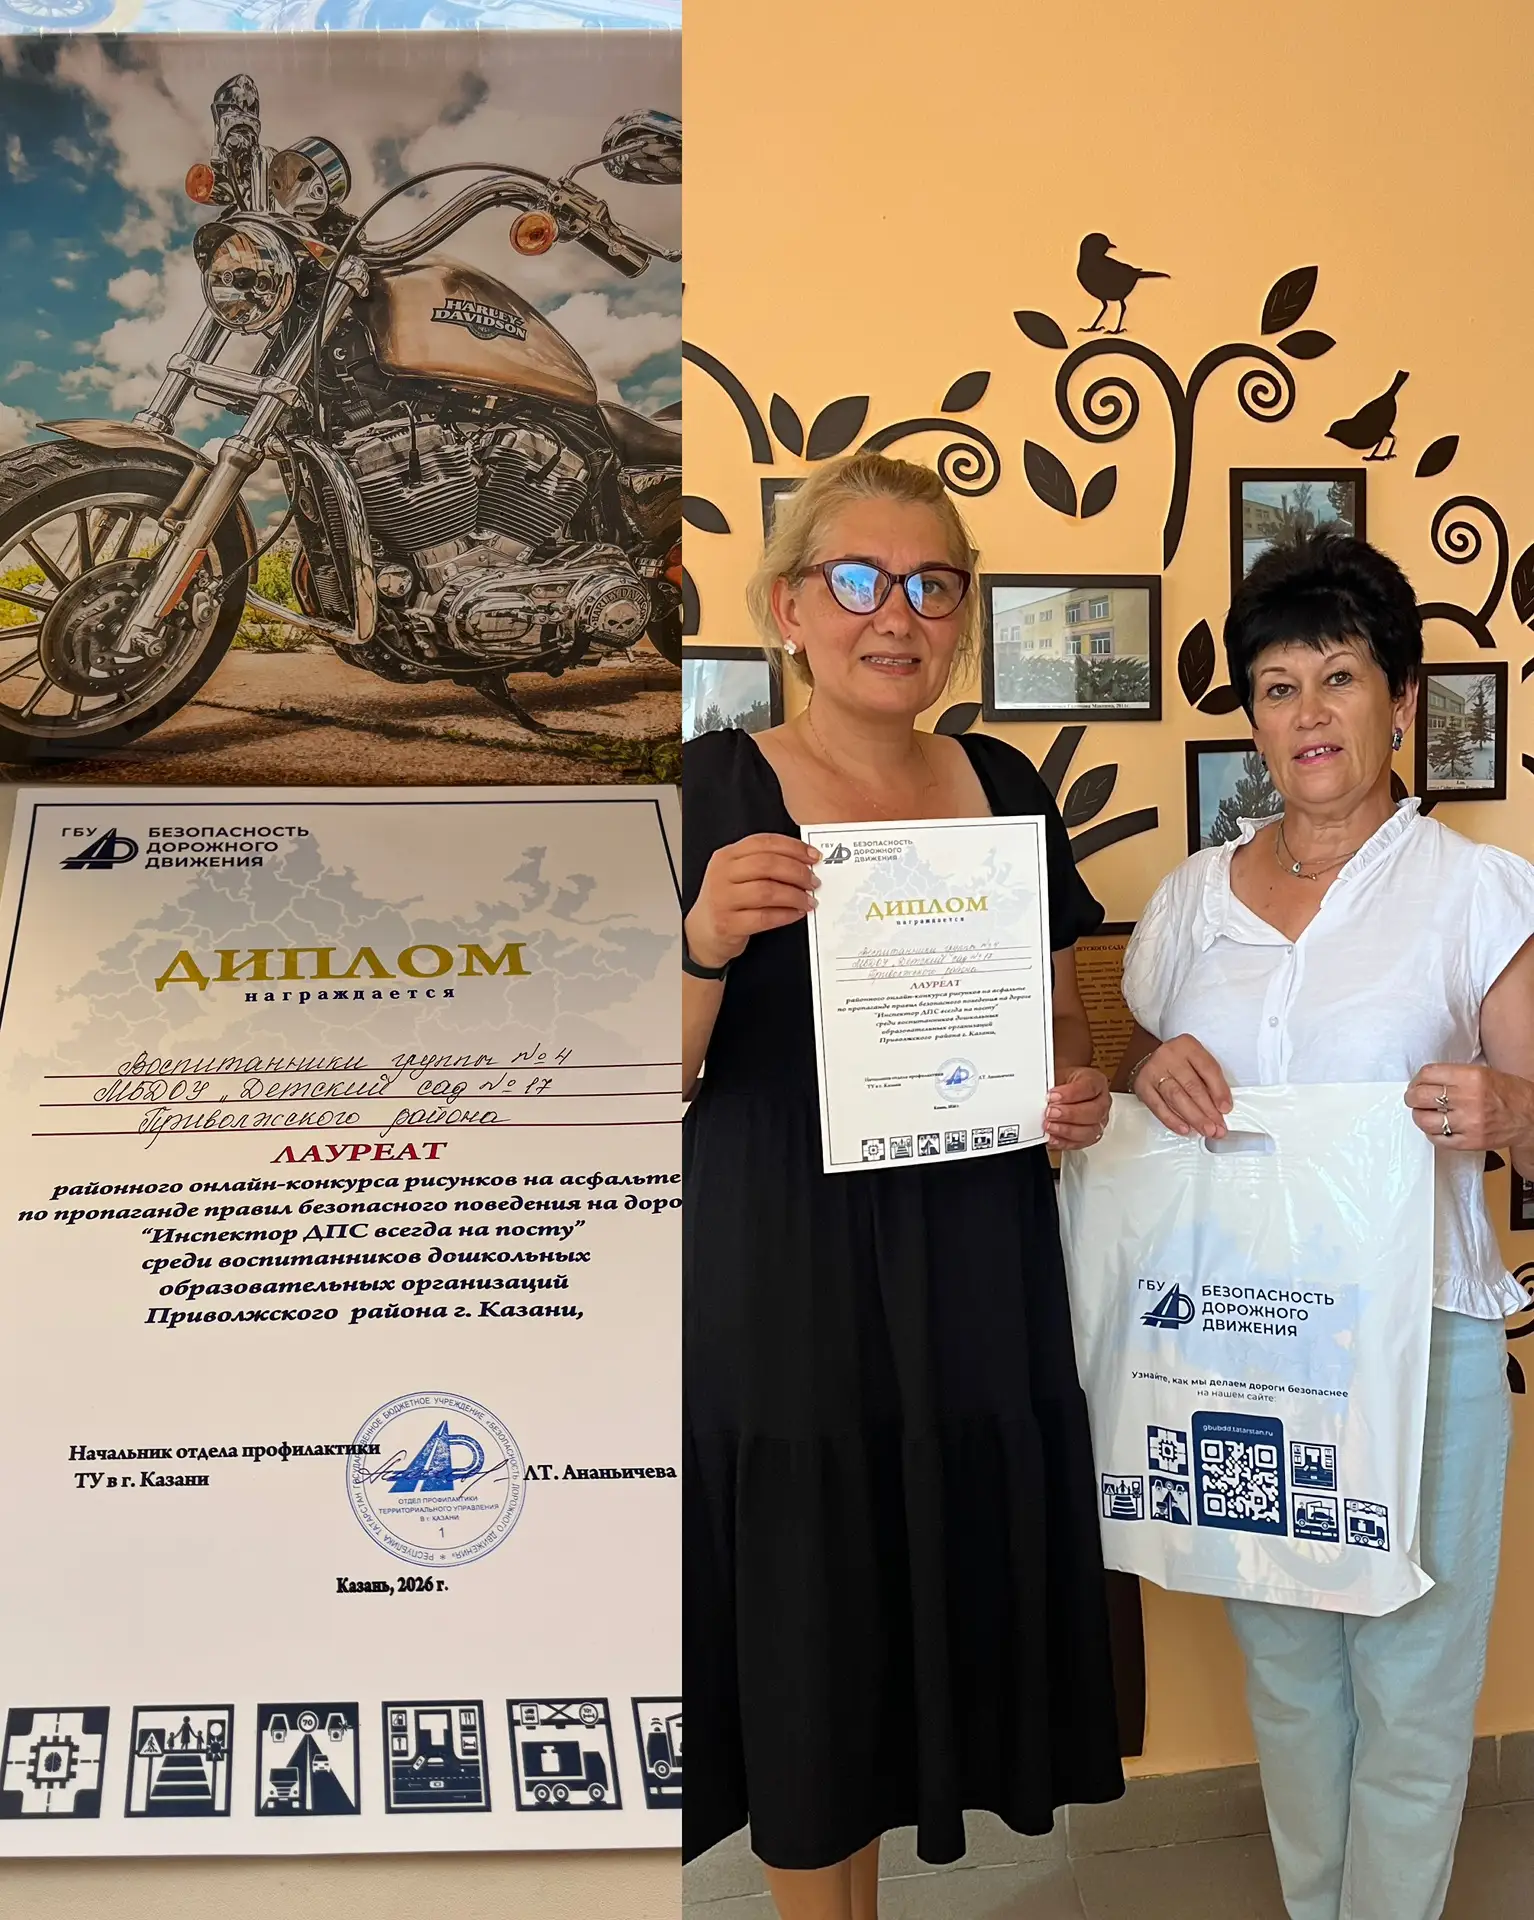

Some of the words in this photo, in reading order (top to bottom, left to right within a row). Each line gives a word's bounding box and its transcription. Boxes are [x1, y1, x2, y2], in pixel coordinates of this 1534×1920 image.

[434, 309, 526, 338] DAVIDSON
[446, 299, 525, 327] HARLEY-
[62, 827, 98, 838] ГБУ
[147, 825, 309, 838] БЕЗОПАСНОСТЬ
[146, 840, 279, 854] ДОРОЖНОГО
[853, 839, 913, 847] БЕЗОПАСНОСТЬ
[853, 847, 902, 855] ДОРОЖНОГО
[144, 855, 264, 869] ДВИЖЕНИЯ
[854, 855, 898, 863] ДВИЖЕНИЯ
[865, 895, 989, 921] ДИПЛОМ
[154, 942, 532, 991] ДИПЛОМ
[244, 985, 457, 1005] награждается
[910, 979, 961, 990] ЛАУРЕАТ
[117, 1050, 368, 1076] Воспитанники
[93, 1078, 210, 1102] МБДОУ
[416, 1078, 468, 1104] сад
[138, 1105, 361, 1150] Приволжского
[379, 1105, 512, 1139] района
[270, 1141, 448, 1164] ЛАУРЕАТ
[49, 1179, 184, 1202] районного
[188, 1176, 400, 1194] онлайн-конкурса
[403, 1174, 518, 1193] рисунков
[523, 1175, 554, 1186] на
[558, 1170, 682, 1191] асфальте
[18, 1210, 49, 1222] по
[53, 1203, 199, 1225] пропаганде
[204, 1204, 293, 1222] правил
[298, 1198, 448, 1215] безопасного
[453, 1196, 582, 1212] поведения
[587, 1199, 619, 1211] на
[302, 1223, 369, 1243] ДПС
[374, 1222, 453, 1238] всегда
[458, 1225, 490, 1237] на
[141, 1252, 213, 1274] среди
[218, 1252, 422, 1268] воспитанников
[427, 1246, 591, 1264] дошкольных
[158, 1278, 396, 1300] образовательных
[401, 1274, 569, 1296] организаций
[1138, 1279, 1165, 1291] ГБУ
[1202, 1285, 1335, 1306] БЕЗОПАСНОСТЬ
[143, 1307, 339, 1329] Приволжского
[348, 1303, 448, 1325] района
[453, 1306, 472, 1318] г.
[478, 1301, 584, 1321] Казани,
[1202, 1302, 1308, 1321] ДОРОЖНОГО
[1202, 1318, 1297, 1337] ДВИЖЕНИЯ
[1131, 1371, 1170, 1384] Узнайте,
[1172, 1377, 1189, 1386] как
[1209, 1379, 1247, 1389] делаем
[1249, 1382, 1285, 1392] дороги
[1288, 1384, 1349, 1398] безопаснее
[1197, 1389, 1209, 1397] на
[1211, 1390, 1245, 1399] нашем
[68, 1445, 173, 1461] Начальник
[176, 1446, 239, 1461] отдела
[242, 1441, 381, 1465] профилактики
[382, 1396, 431, 1420] БЮДЖЕТНОЕ
[433, 1396, 485, 1421] УЧРЕЖДЕНИЕ
[496, 1483, 521, 1533] ДОРОЖНОГО
[562, 1464, 678, 1480] Ананьичева
[74, 1472, 106, 1489] ТУ
[106, 1476, 117, 1488] в
[120, 1476, 136, 1488] г.
[139, 1471, 210, 1488] Казани
[378, 1505, 452, 1514] ТЕРРИТОРИАЛЬНОГО
[453, 1503, 500, 1513] УПРАВЛЕНИЯ
[398, 1497, 422, 1505] ОТДЕЛ
[423, 1495, 478, 1504] ПРОФИЛАКТИКИ
[335, 1576, 396, 1597] Казань,
[397, 1575, 433, 1593] 2026
[435, 1580, 449, 1592] г.
